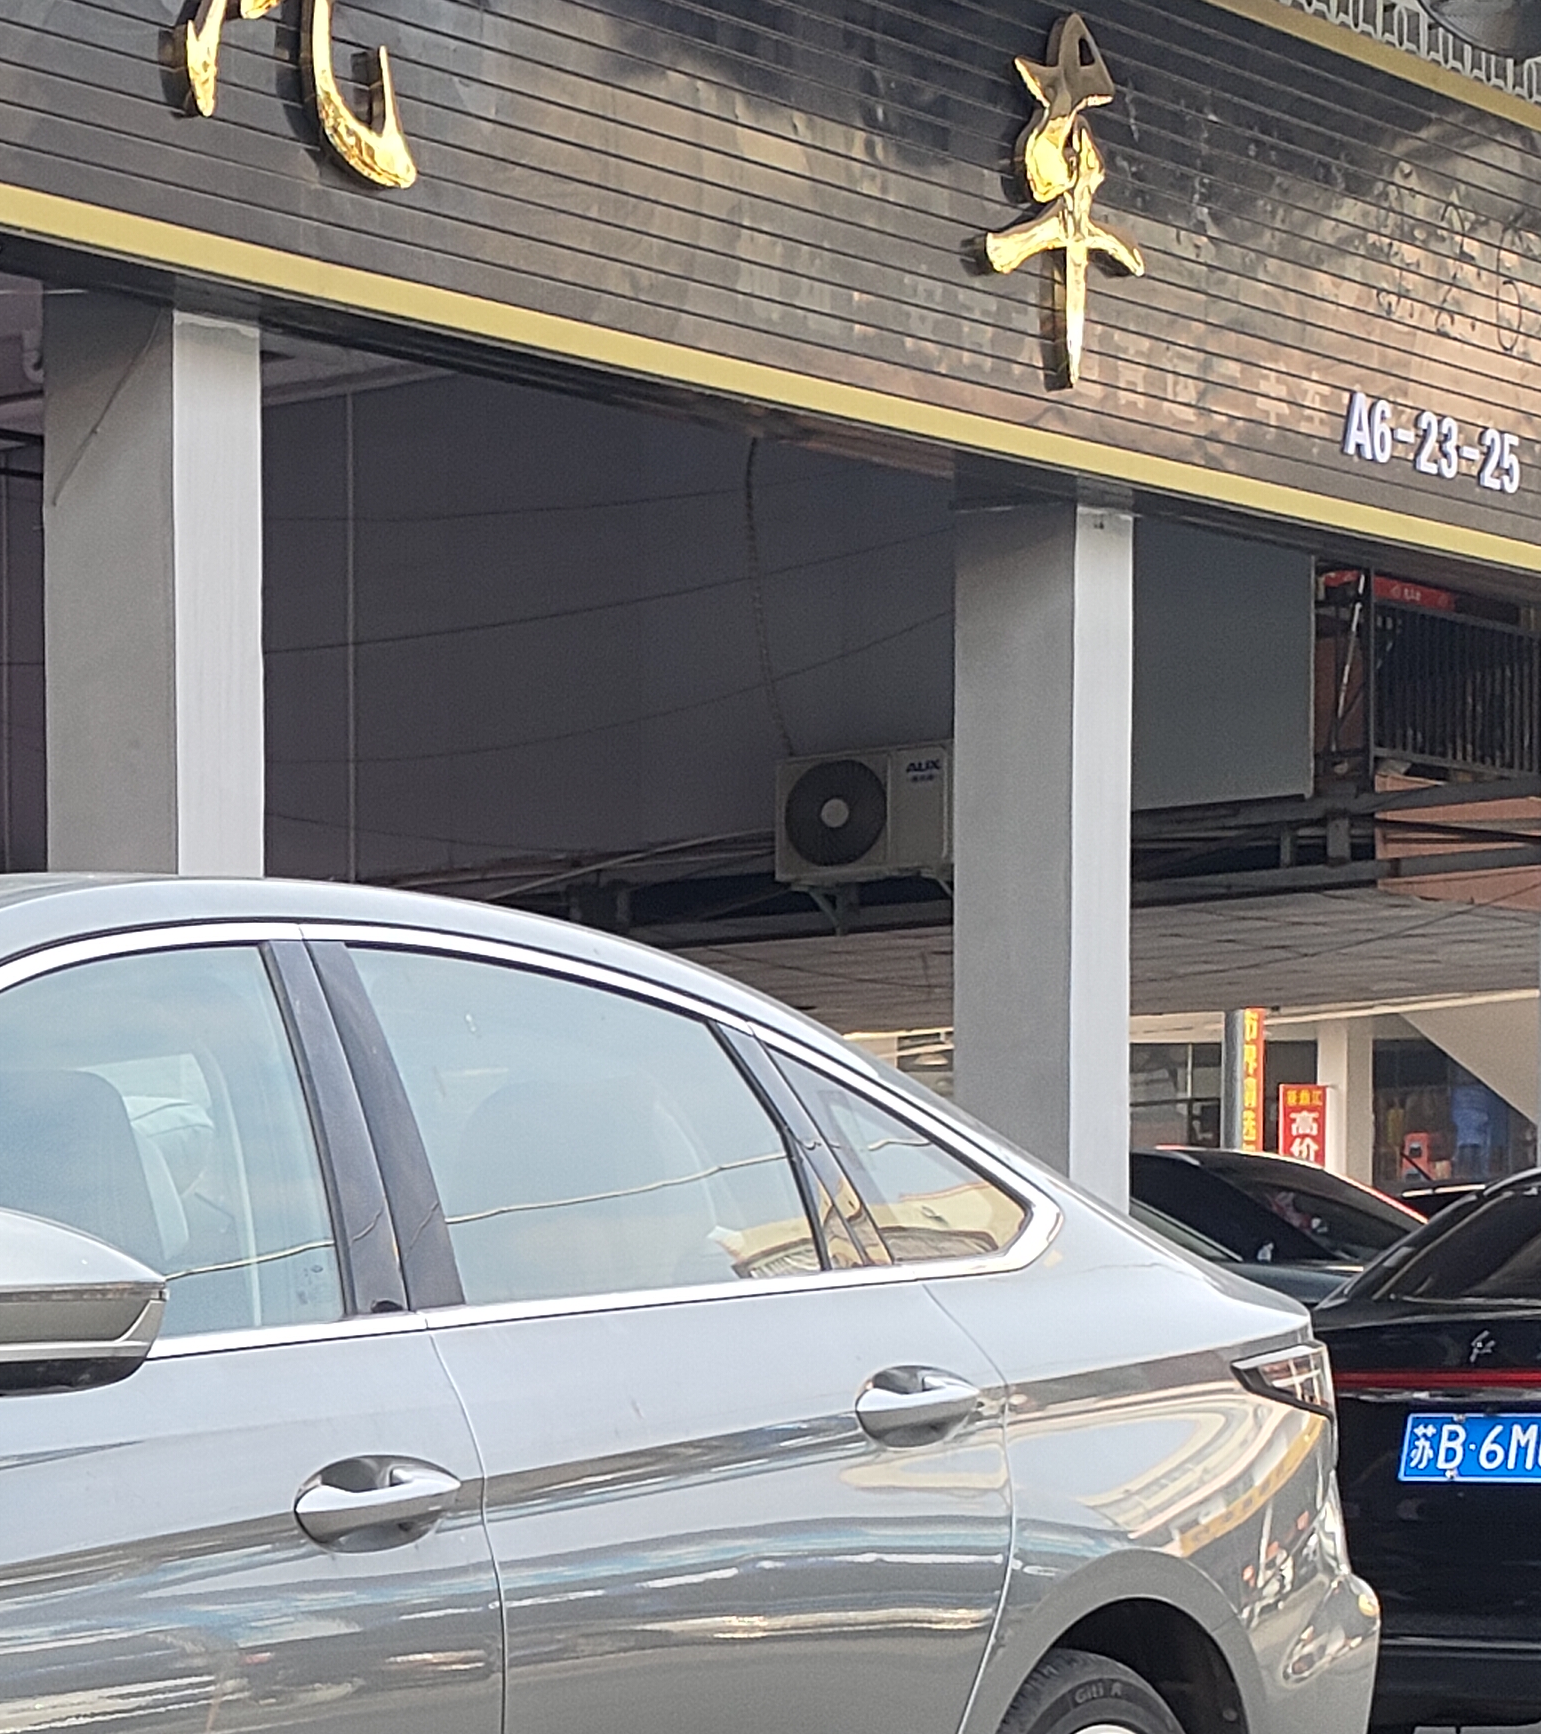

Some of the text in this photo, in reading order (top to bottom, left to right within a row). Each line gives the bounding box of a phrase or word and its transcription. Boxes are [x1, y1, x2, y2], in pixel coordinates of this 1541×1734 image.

[1343, 391, 1520, 493] A6-23-25
[1289, 1110, 1320, 1162] 高价
[1409, 1423, 1541, 1470] 苏B·6M
